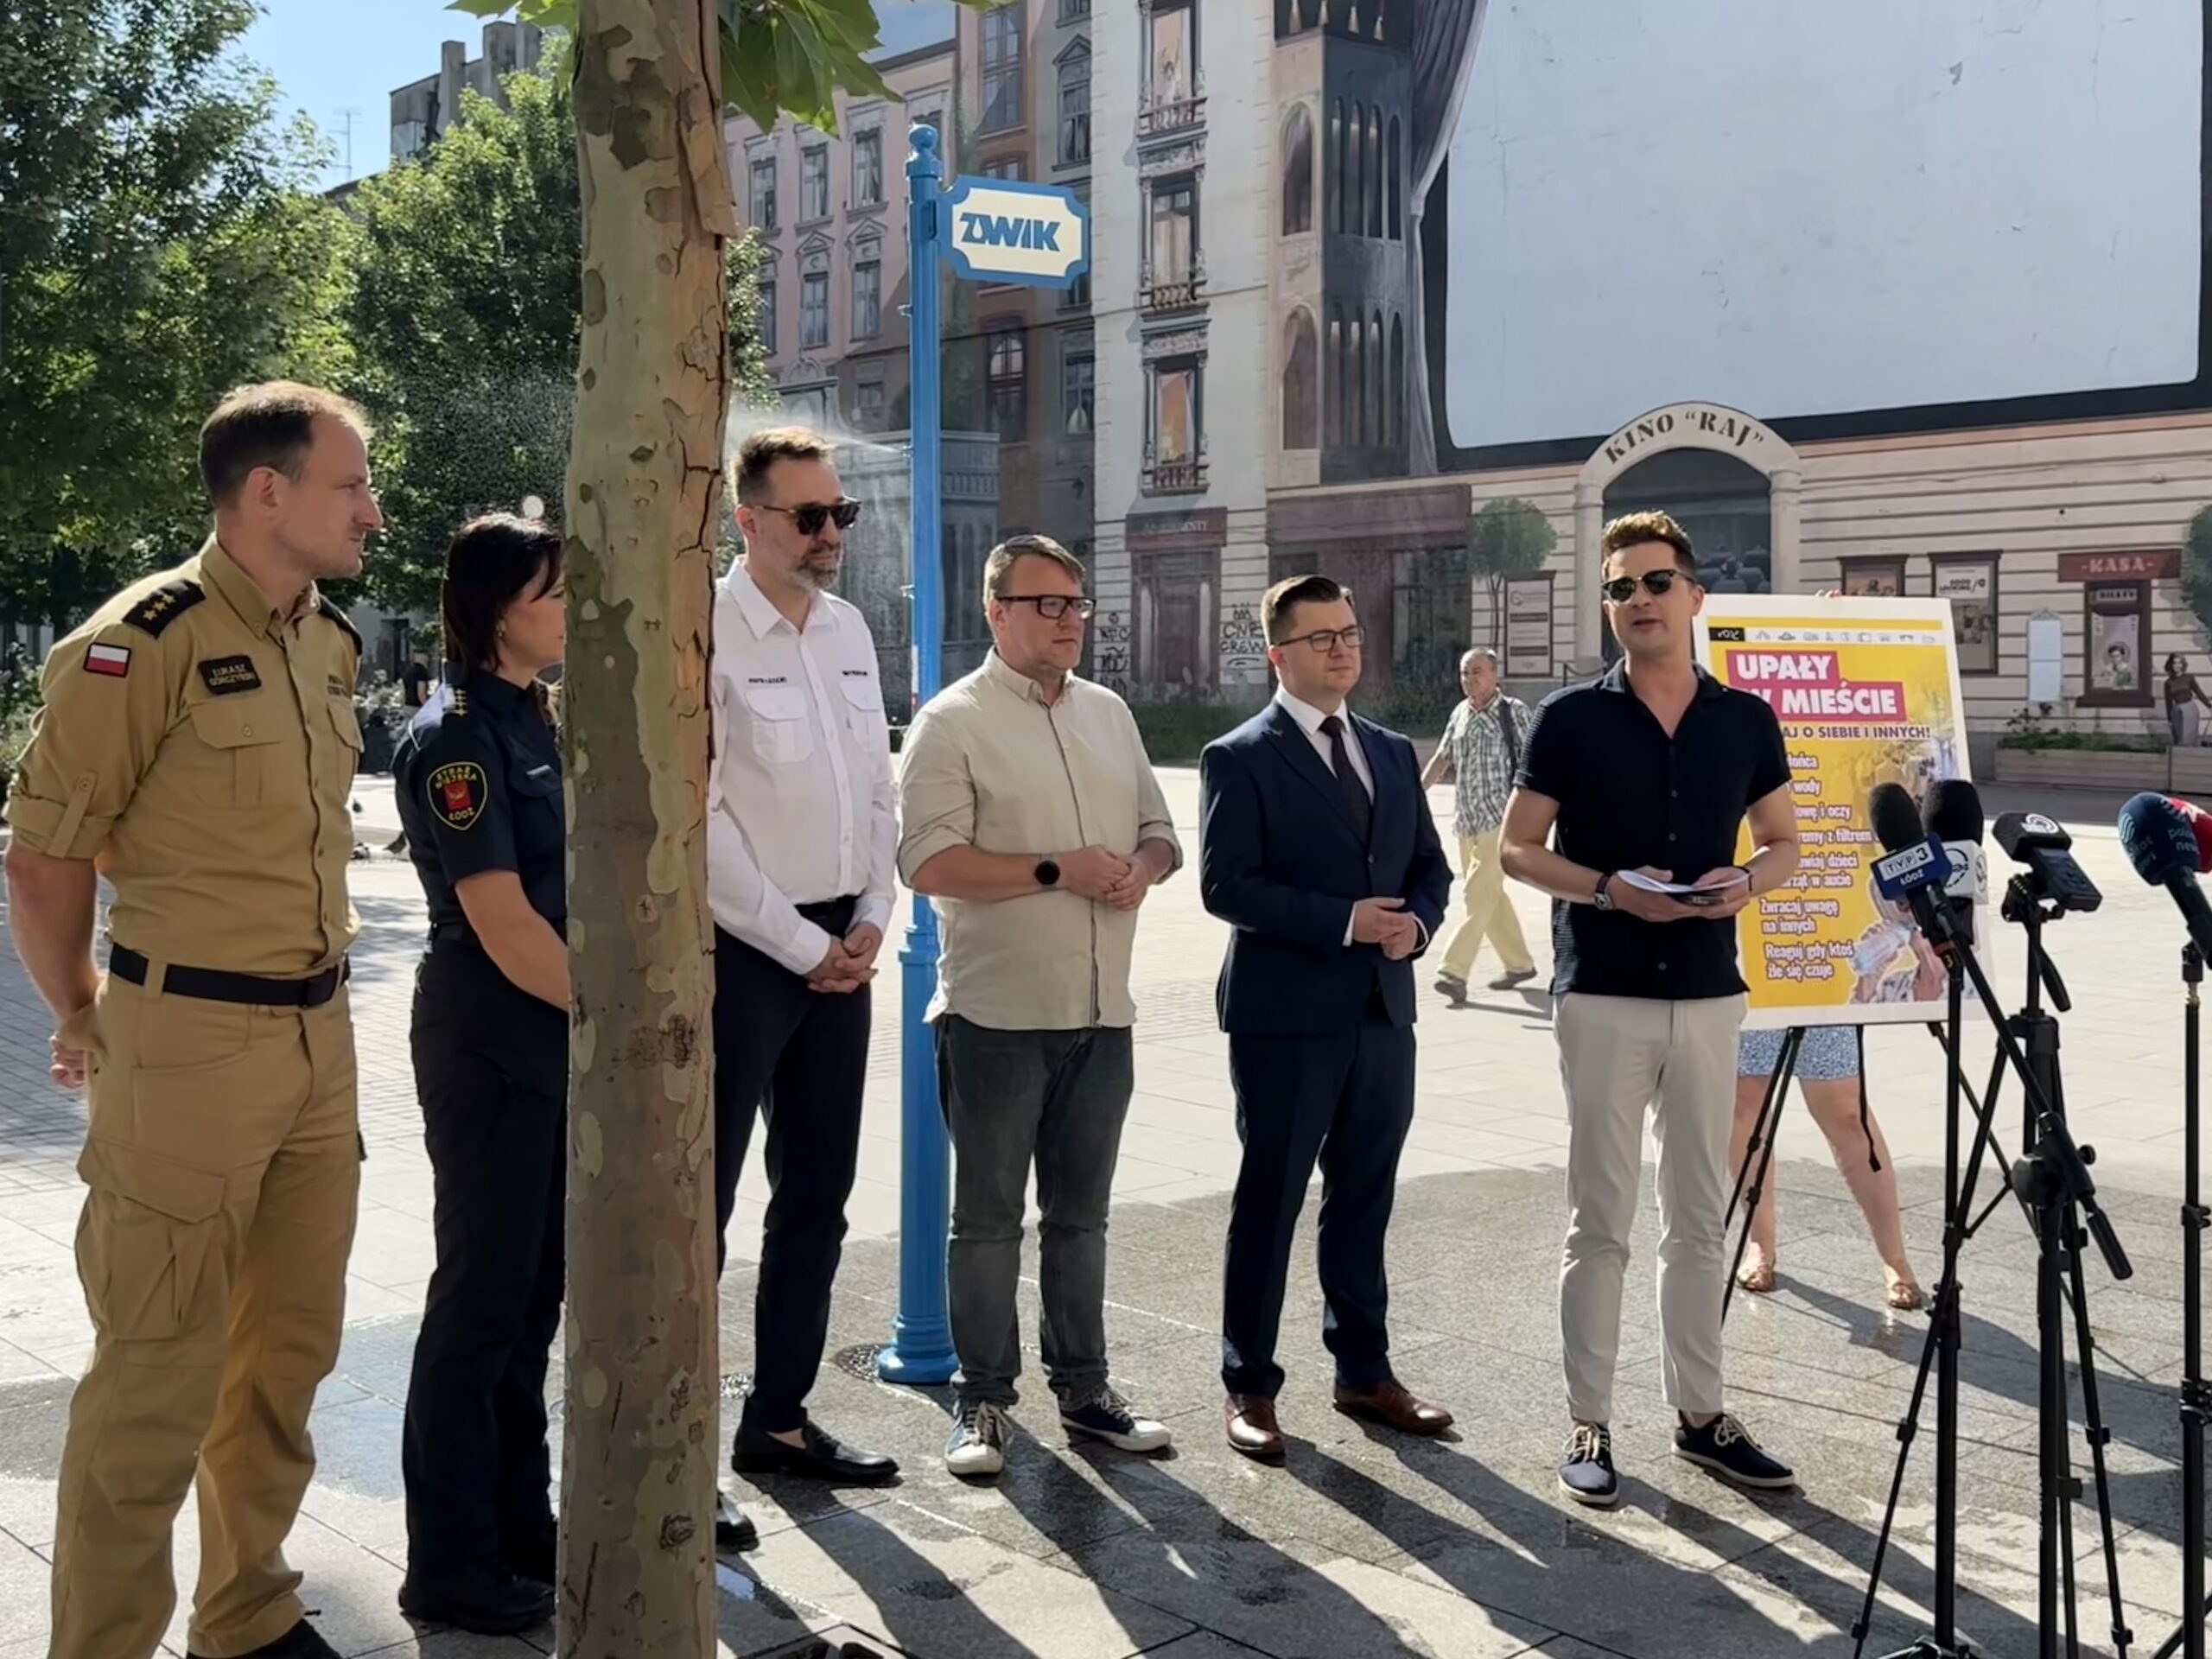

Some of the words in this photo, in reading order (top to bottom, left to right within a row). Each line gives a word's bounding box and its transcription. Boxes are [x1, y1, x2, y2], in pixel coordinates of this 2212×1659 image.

[960, 212, 1061, 252] ZWIK
[1605, 413, 1675, 464] KINO
[1736, 653, 1833, 681] UPAŁY
[1782, 681, 1897, 715] MIEŚCIE
[1783, 727, 1798, 739] AJ
[1802, 727, 1815, 739] O
[1818, 727, 1861, 739] SIEBIE
[1864, 727, 1869, 739] I
[1873, 727, 1931, 740] INNYCH!
[1793, 779, 1821, 796] wody
[1827, 805, 1851, 821] oczy
[1827, 832, 1834, 843] z
[1835, 828, 1873, 843] filtrem
[1827, 853, 1858, 868] dzieci
[1823, 872, 1853, 887] aucie
[1760, 897, 1802, 916] Zwracaj
[1803, 899, 1839, 917] uwagę
[1762, 920, 1777, 934] na
[1779, 916, 1816, 935] innych
[1765, 943, 1803, 961] Reaguj
[1806, 942, 1826, 961] gdy
[1828, 940, 1855, 957] ktoś
[1768, 961, 1783, 978] źle
[1786, 962, 1802, 982] się
[1804, 961, 1834, 980] czuje
